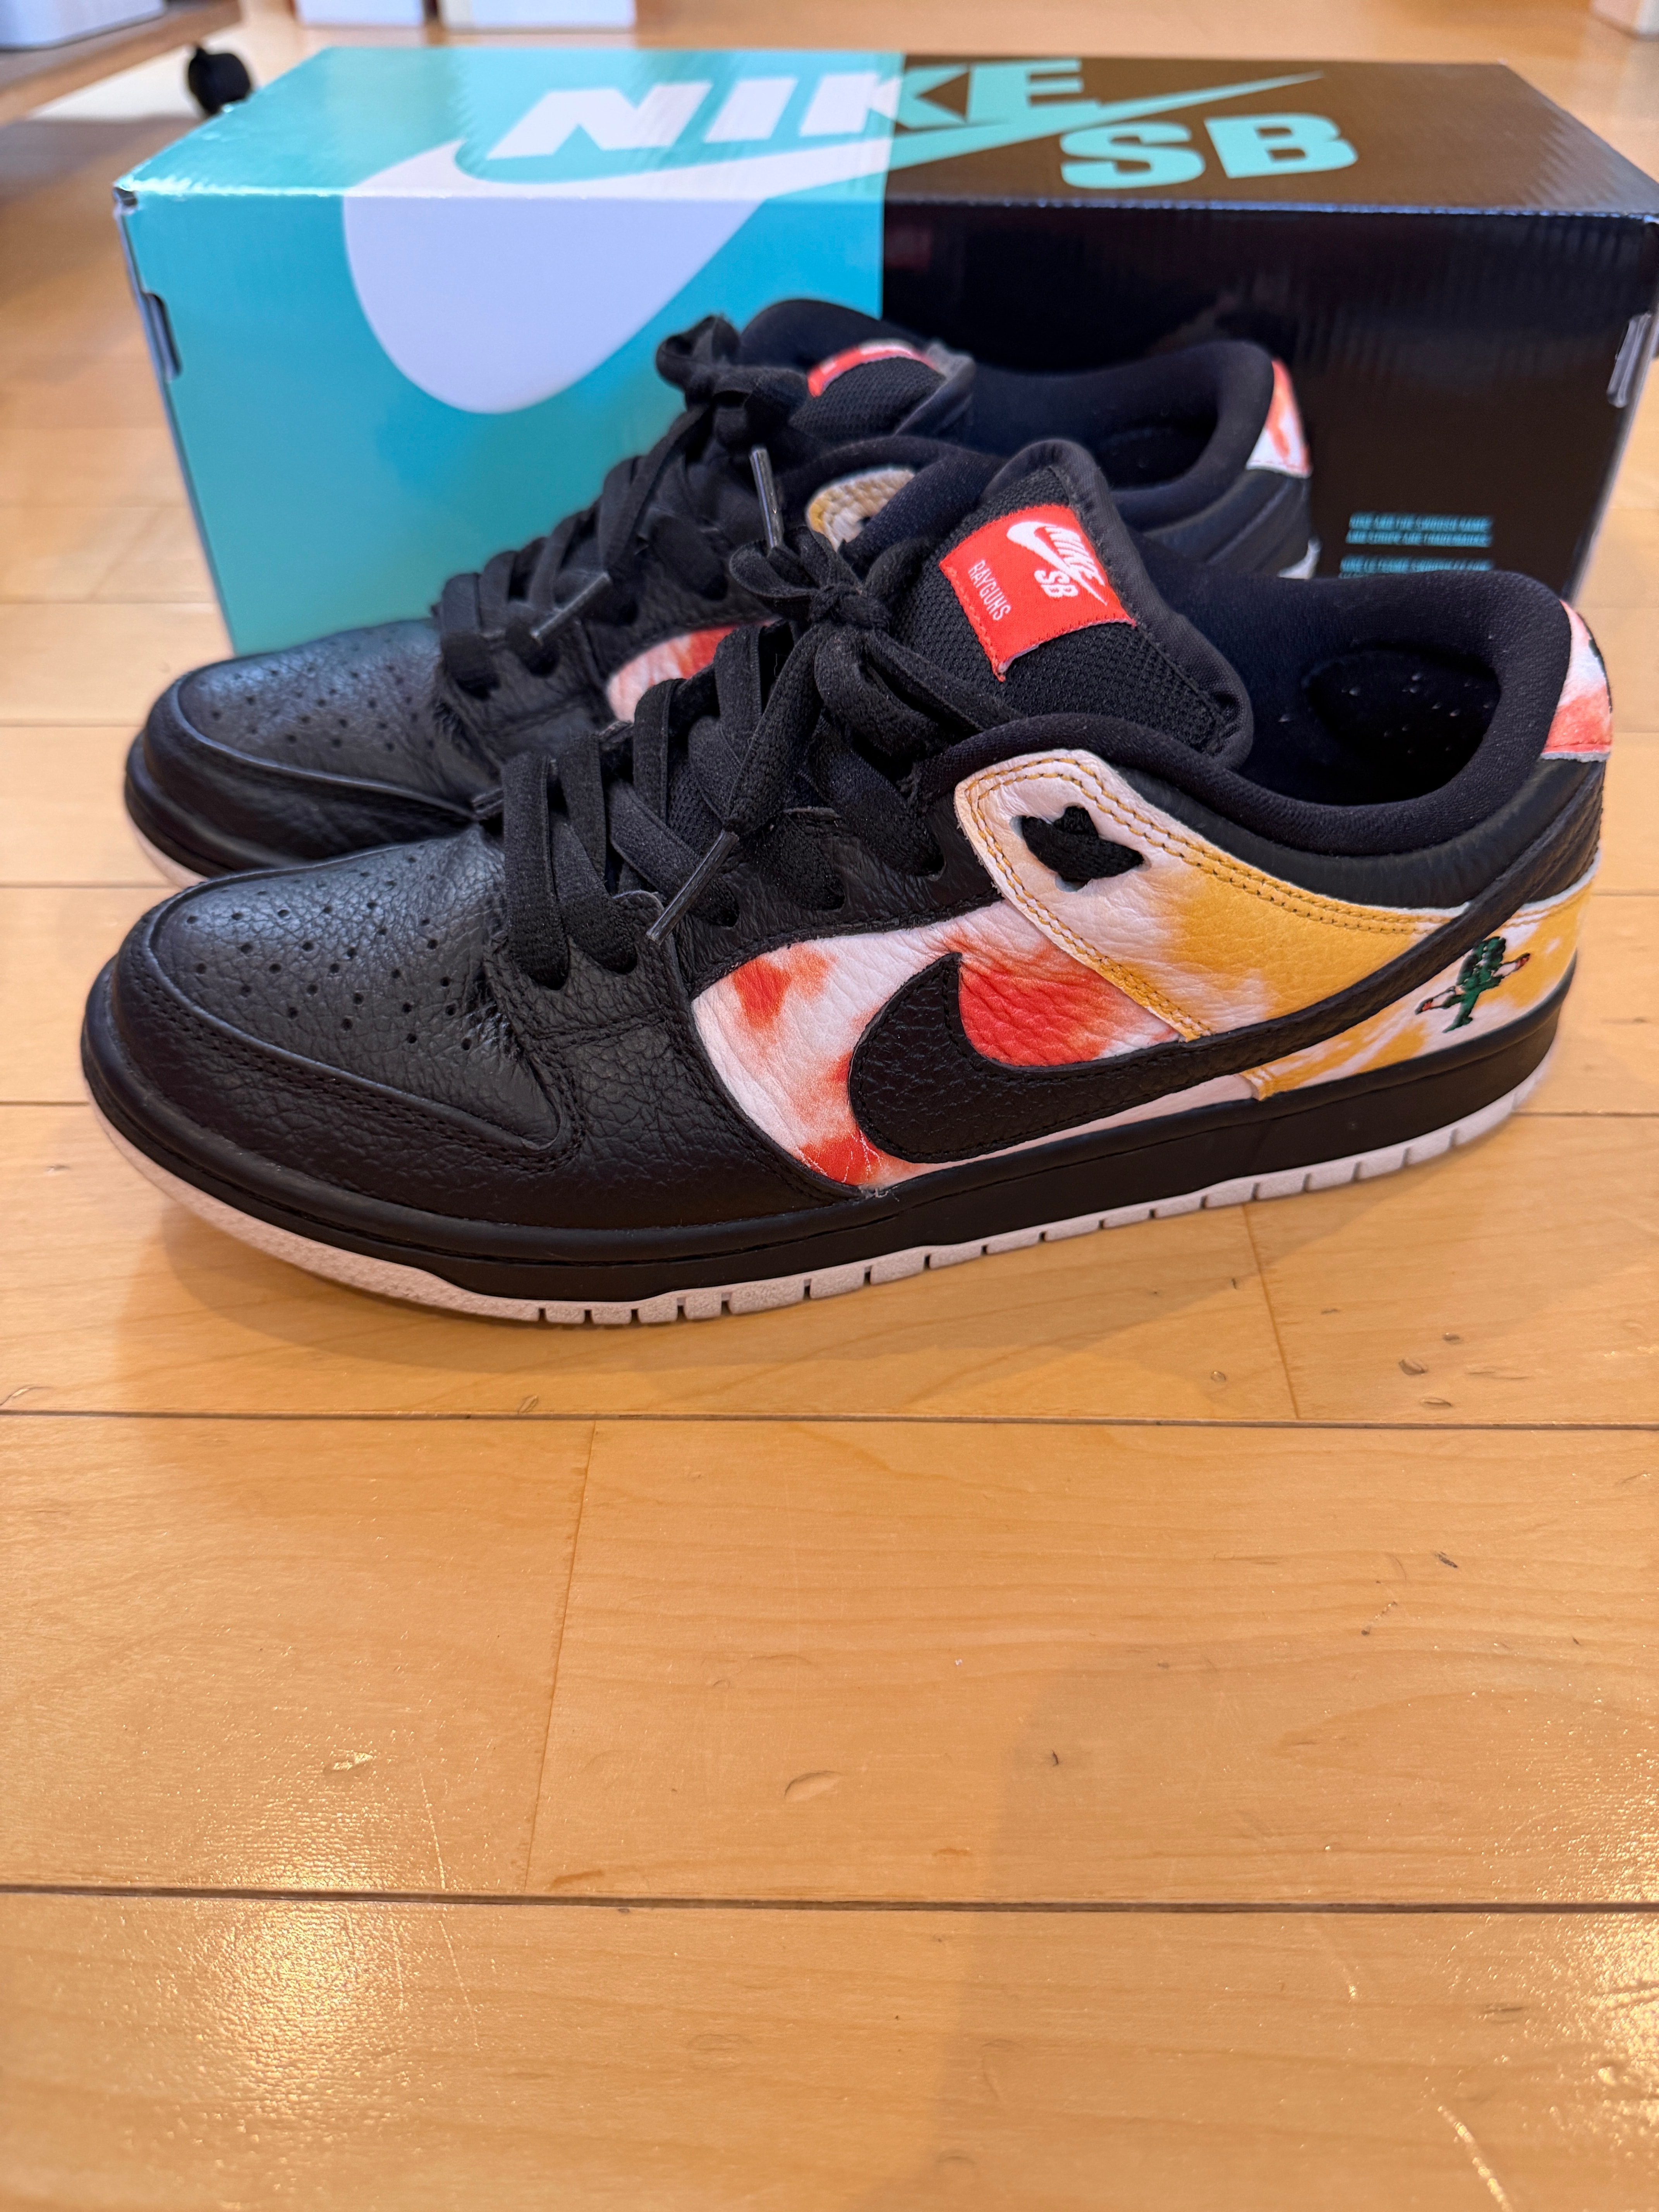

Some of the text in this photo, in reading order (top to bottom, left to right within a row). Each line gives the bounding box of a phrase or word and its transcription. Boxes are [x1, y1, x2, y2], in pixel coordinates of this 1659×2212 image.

[486, 58, 1101, 160] NIKE
[1060, 112, 1358, 189] SB
[1034, 570, 1079, 598] SB
[1045, 525, 1105, 586] NIKE
[968, 559, 1011, 620] RAYGUNS
